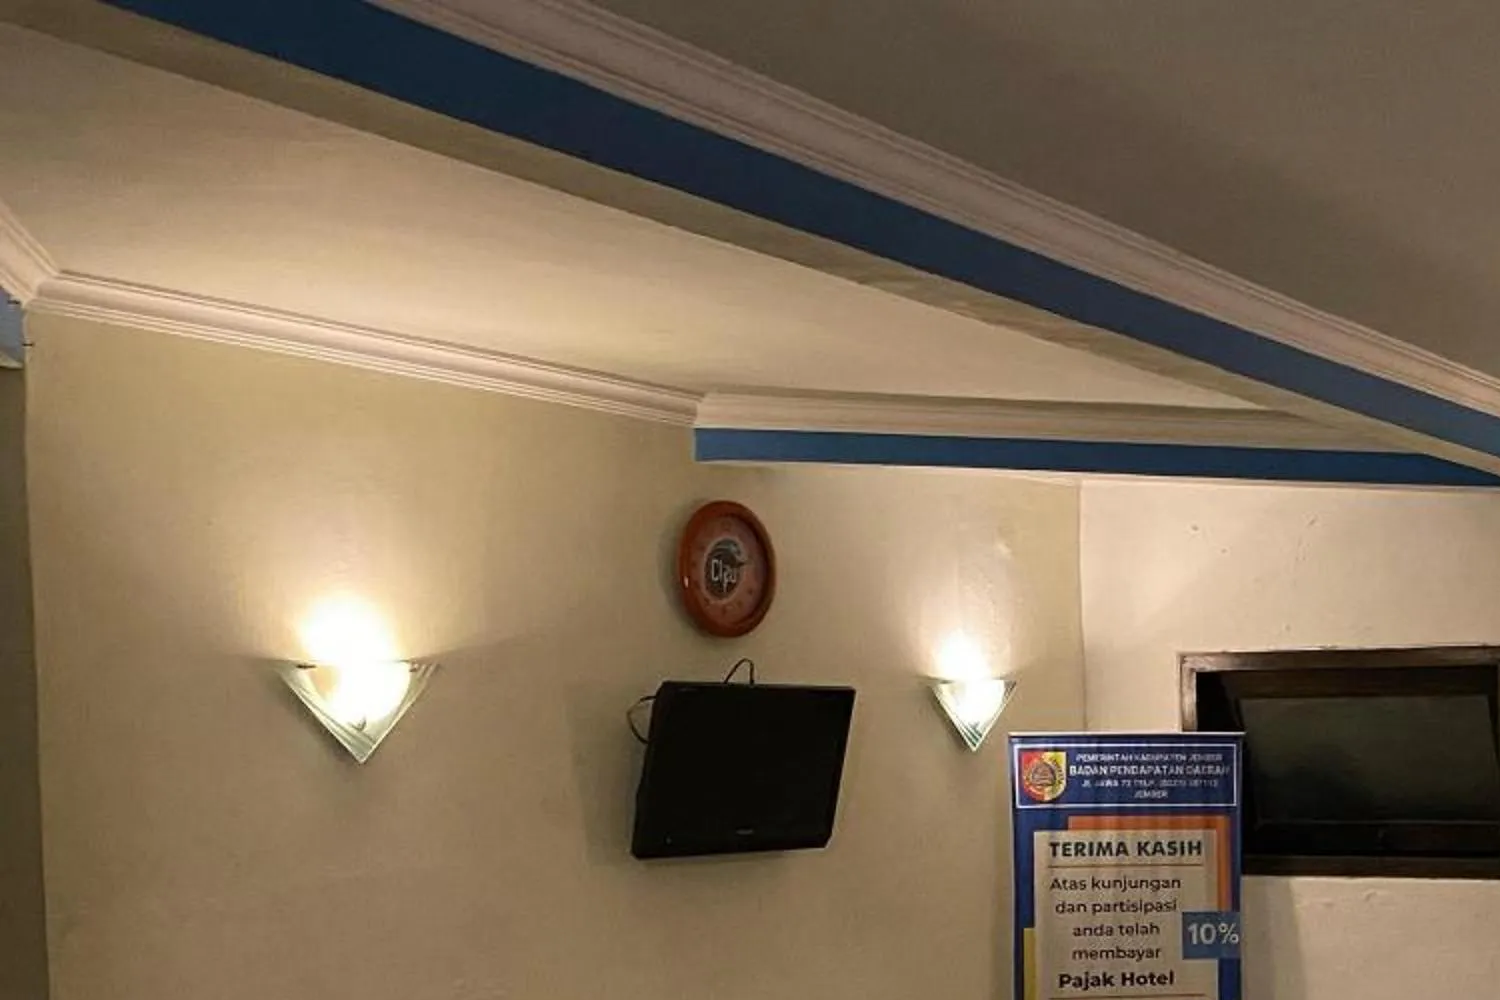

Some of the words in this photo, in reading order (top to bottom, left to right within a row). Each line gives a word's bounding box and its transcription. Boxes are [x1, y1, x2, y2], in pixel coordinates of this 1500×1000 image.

[1069, 765, 1107, 776] BADAN
[1109, 765, 1184, 776] PENDAPATAN
[1186, 765, 1231, 776] DAERAH
[1134, 790, 1169, 799] JEMBER
[1049, 841, 1130, 857] TERIMA
[1137, 840, 1202, 857] KASIH
[1050, 877, 1087, 891] Atas
[1091, 875, 1182, 892] kunjungan
[1055, 900, 1088, 915] dan
[1092, 899, 1178, 917] partisipasi
[1072, 923, 1113, 938] anda
[1118, 922, 1161, 937] telah
[1188, 922, 1240, 945] 10%
[1072, 945, 1162, 962] membayar
[1058, 971, 1115, 991] Pajak
[1121, 969, 1175, 986] Hotel
